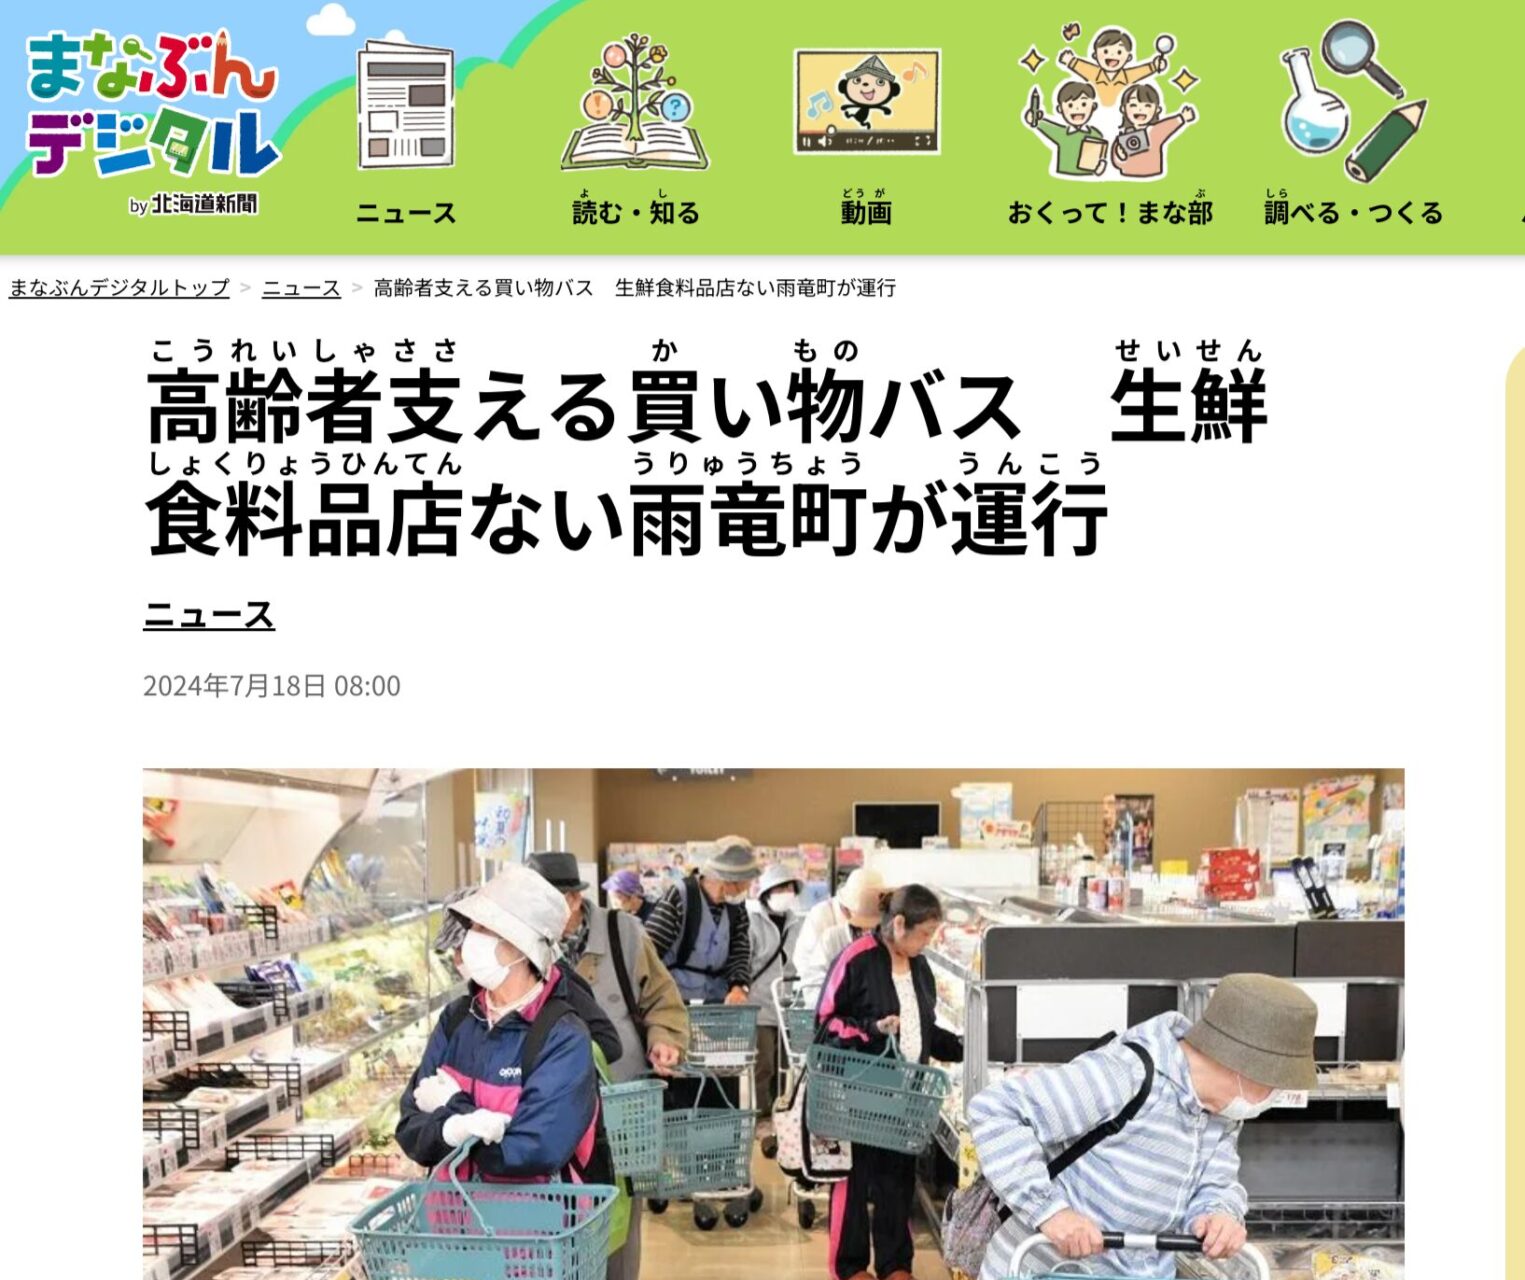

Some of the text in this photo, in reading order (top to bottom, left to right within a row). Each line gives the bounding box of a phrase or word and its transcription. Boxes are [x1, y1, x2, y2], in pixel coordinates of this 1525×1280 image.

[29, 30, 275, 98] まなぶん
[29, 107, 279, 175] デジタル
[130, 193, 258, 214] by 北海道新聞
[580, 188, 667, 198] よ し
[842, 188, 887, 198] どうが
[1266, 188, 1288, 198] しら
[357, 203, 455, 223] ニュース
[573, 202, 698, 224] 読む・知る
[841, 201, 891, 225] 動画
[1008, 201, 1212, 225] おくって！まな部
[1265, 201, 1442, 225] 調べる・つくる
[8, 278, 230, 299] まなぶんデジタルトップ
[262, 279, 342, 299] ニュース
[375, 278, 896, 297] 高齢者支える買い物バス 生鮮食料品店ない雨竜町が運行
[154, 338, 1261, 363] こうれいしゃささ か もの せいせん
[147, 367, 1267, 444] 高齢者支える買い物バス 生鮮
[151, 451, 1099, 476] しょくりょうひんてん うりゅうちょう うんこう
[145, 479, 1107, 557] 食料品店ない雨竜町が運行
[143, 602, 276, 631] ニュース
[144, 673, 400, 698] 2024年7月18日 08:00
